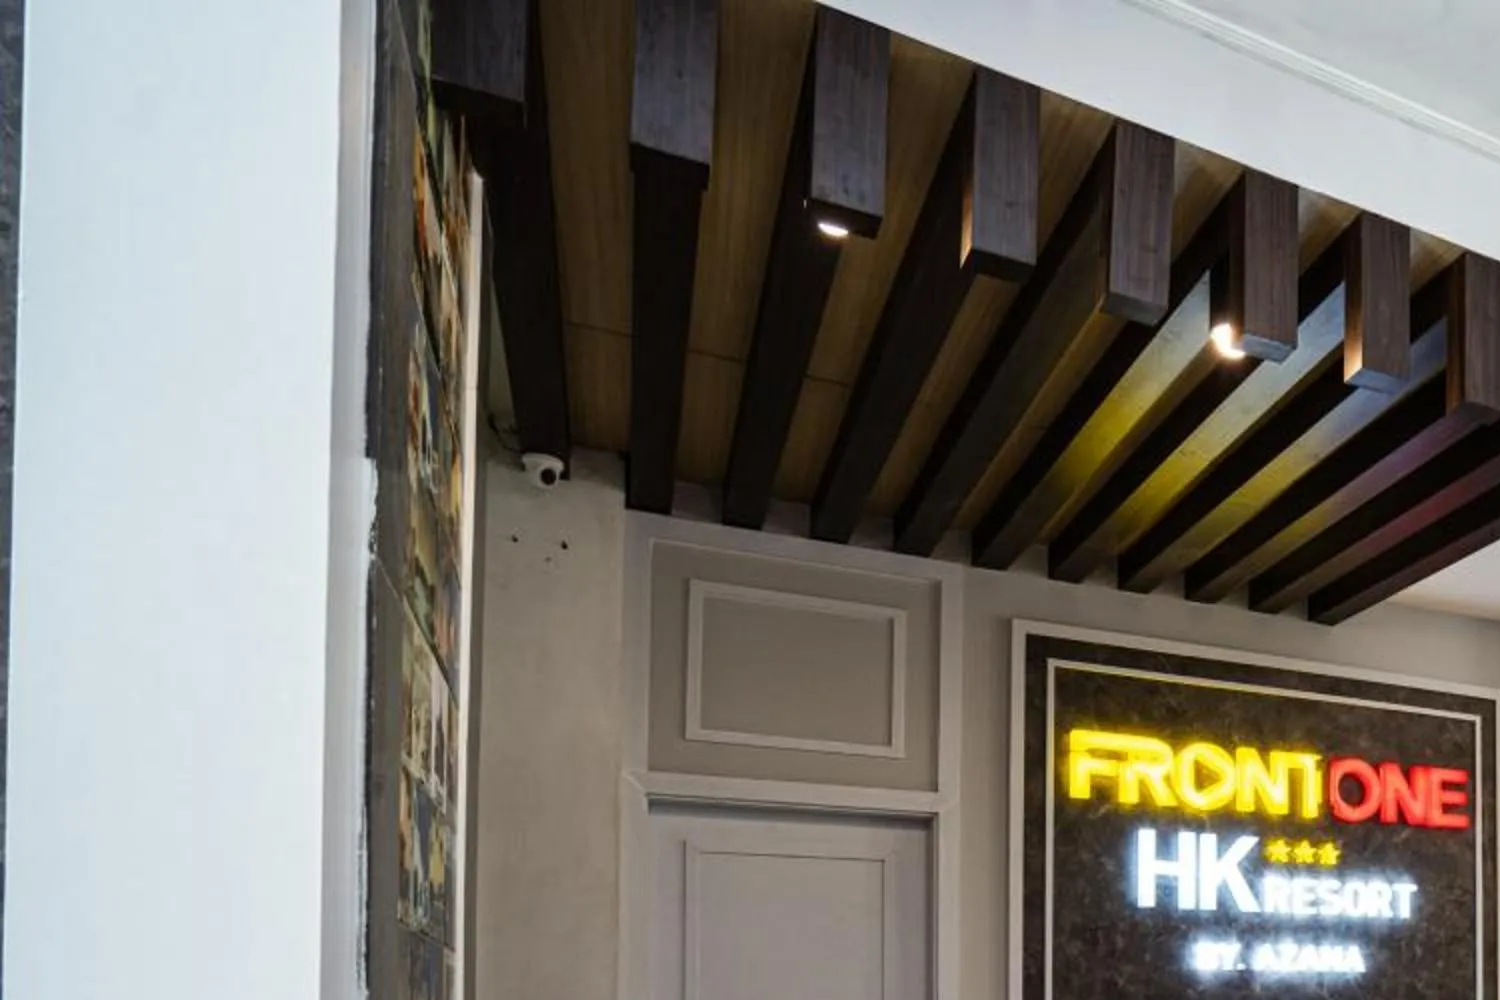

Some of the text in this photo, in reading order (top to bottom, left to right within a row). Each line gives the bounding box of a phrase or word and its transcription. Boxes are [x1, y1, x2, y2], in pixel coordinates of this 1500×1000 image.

[1067, 728, 1470, 829] FRONT ONE
[1136, 828, 1419, 919] HK RESORT
